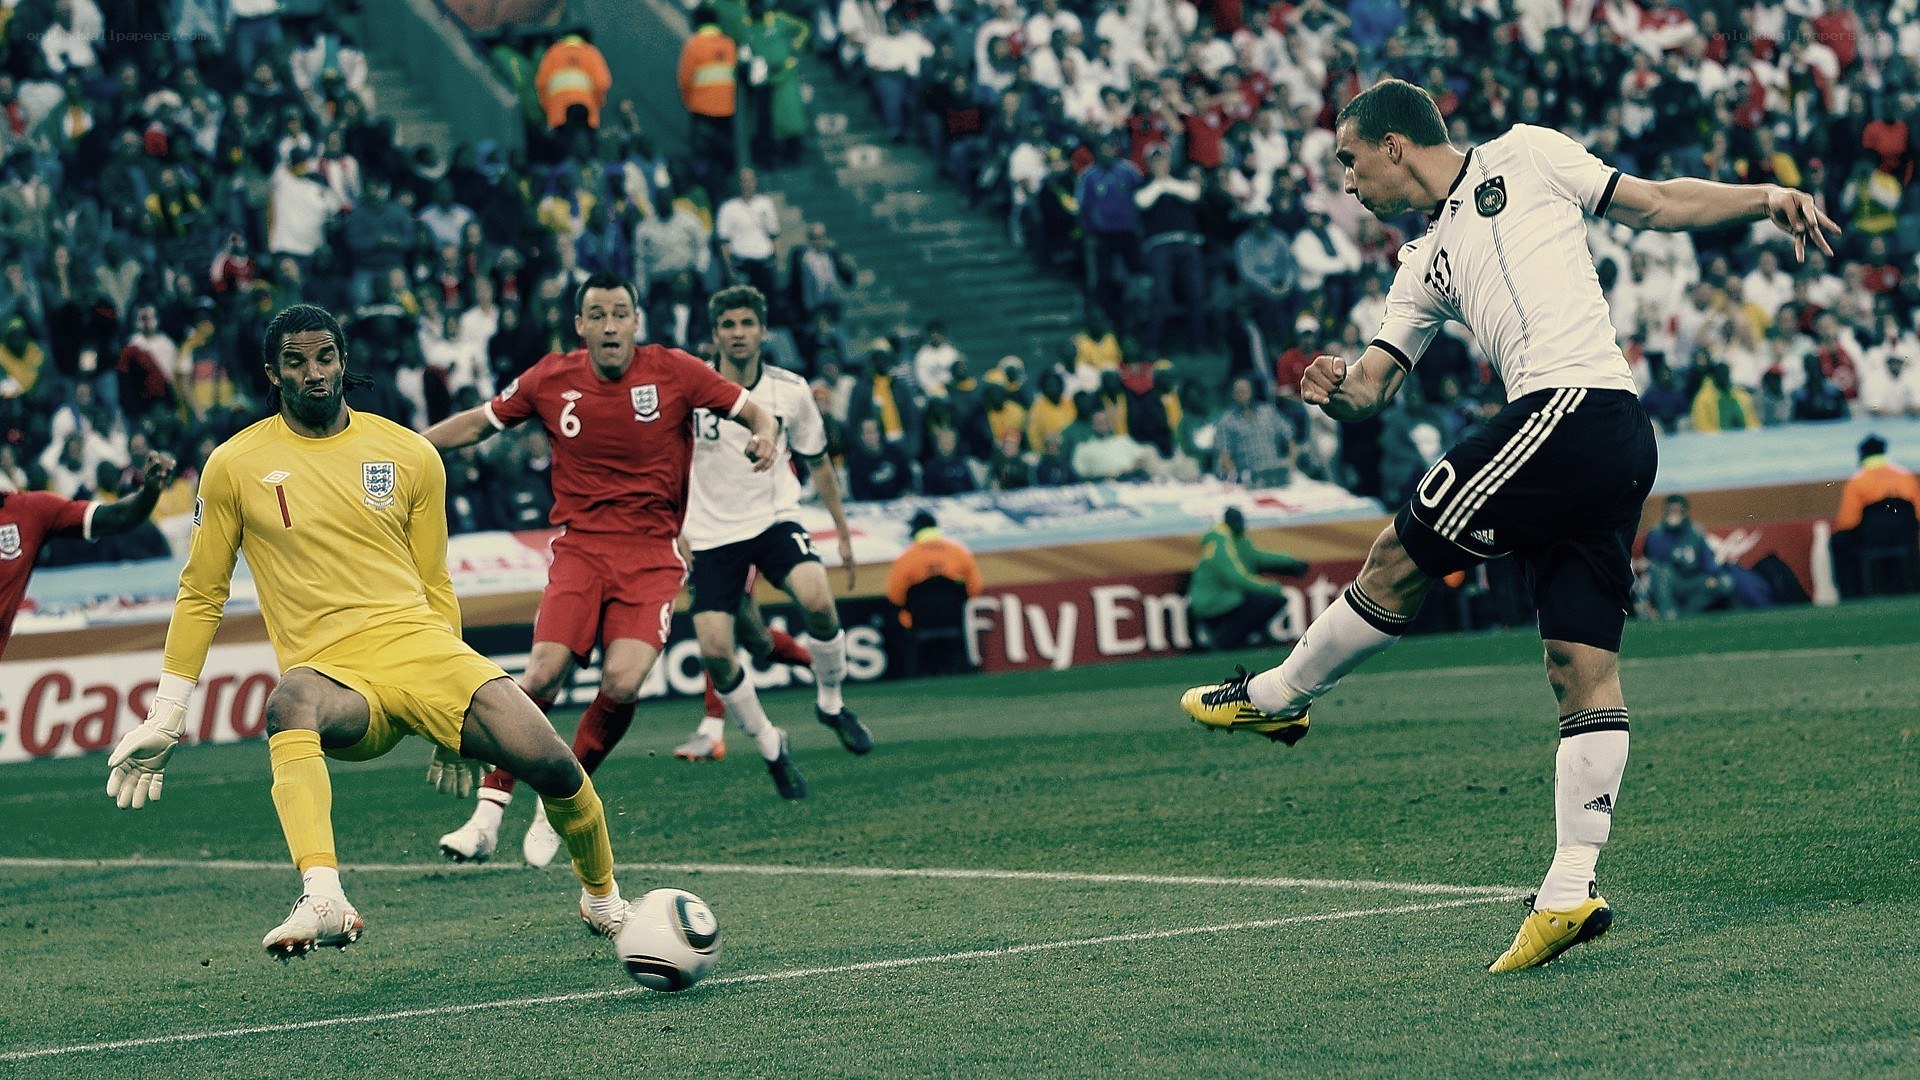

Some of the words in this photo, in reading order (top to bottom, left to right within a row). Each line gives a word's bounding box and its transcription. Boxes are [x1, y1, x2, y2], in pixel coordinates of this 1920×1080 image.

[559, 401, 582, 438] 6
[694, 408, 719, 440] 13
[275, 484, 292, 529] 1
[965, 594, 1079, 670] Fly
[1091, 577, 1352, 656] Emat
[20, 671, 280, 756] Caro
